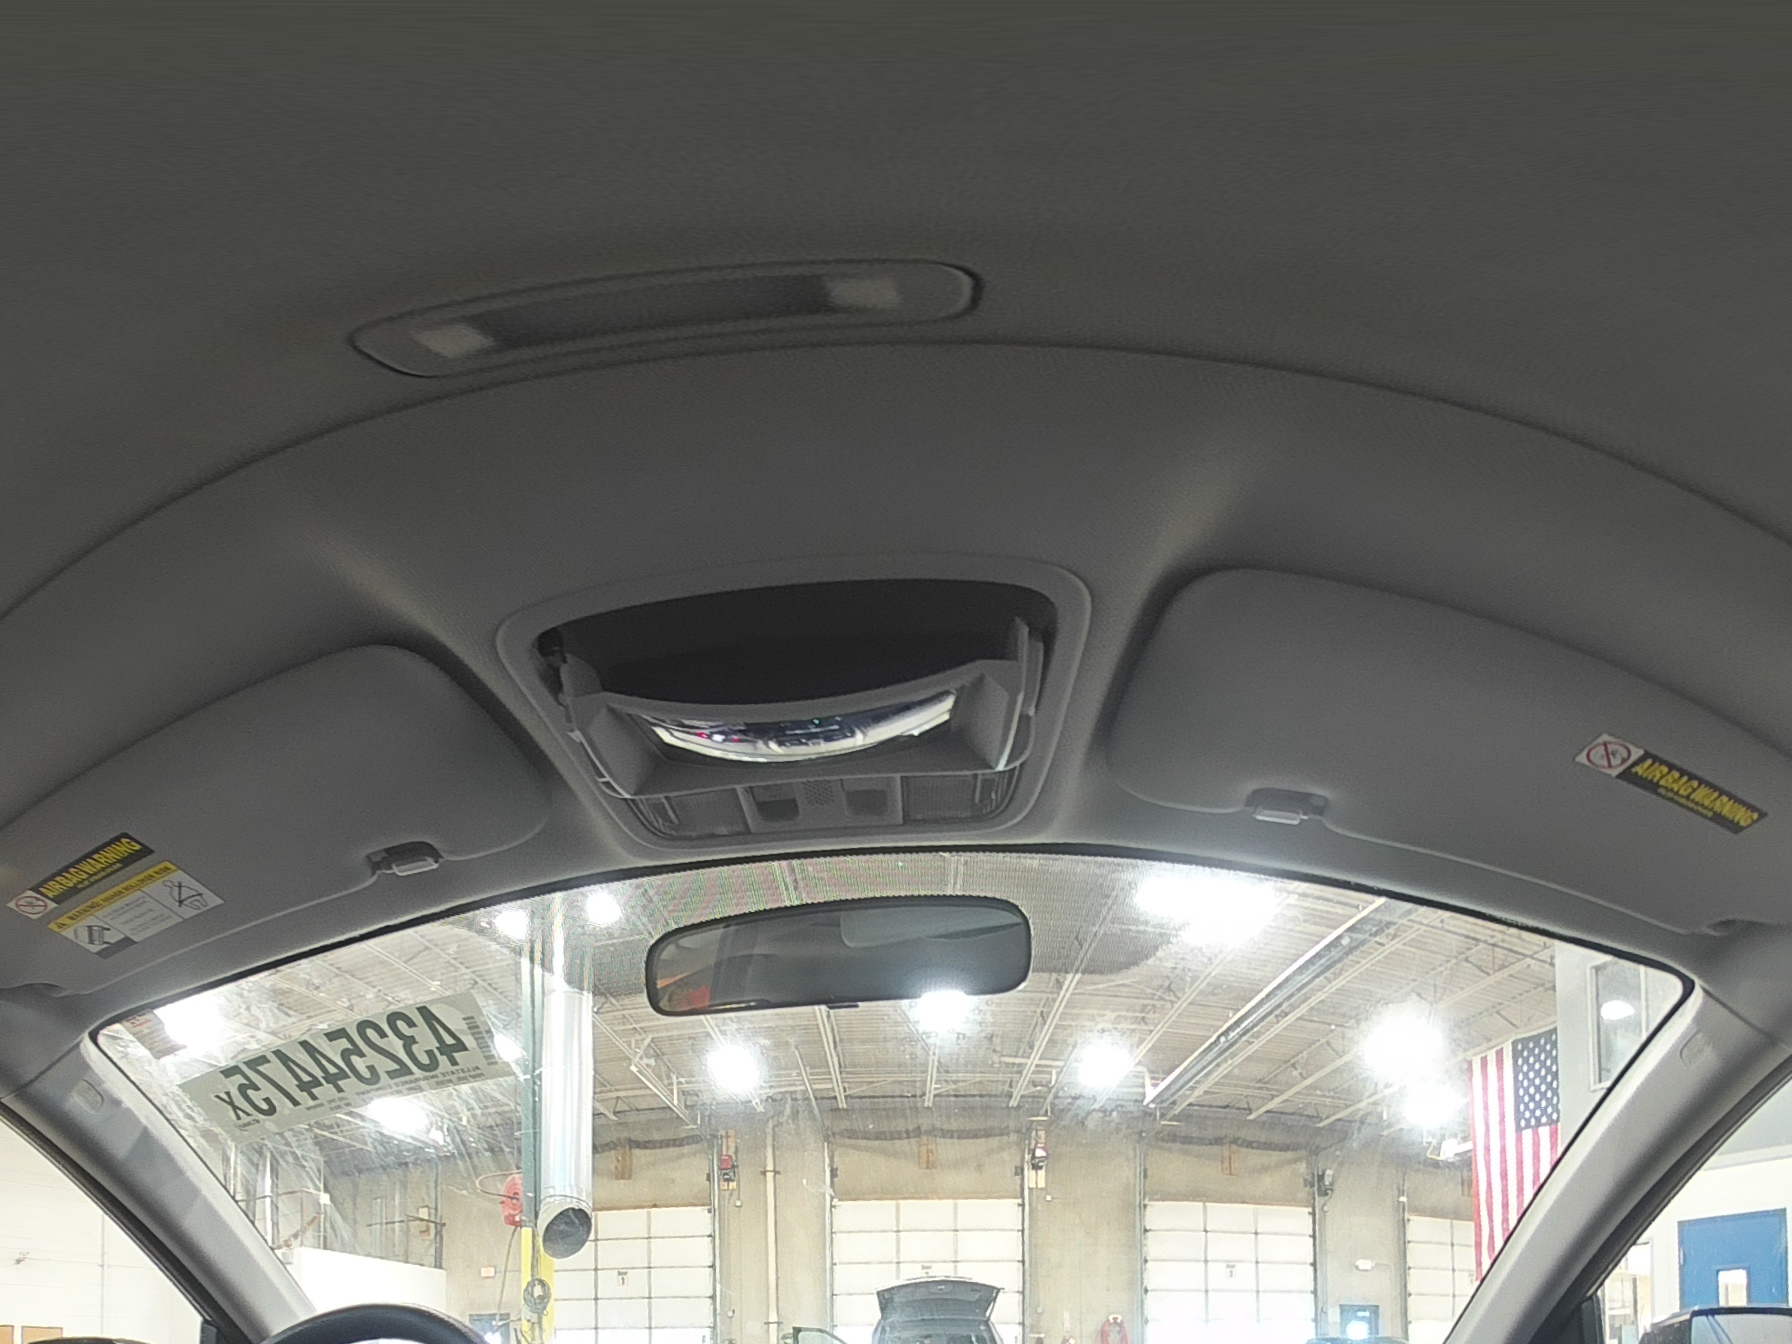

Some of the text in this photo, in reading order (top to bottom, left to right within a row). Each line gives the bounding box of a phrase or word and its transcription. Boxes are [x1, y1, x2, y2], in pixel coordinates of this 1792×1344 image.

[1632, 758, 1699, 796] AIRBAG
[1690, 783, 1758, 827] WARNING
[38, 865, 88, 899] AIRBAG
[74, 837, 143, 875] WARNING
